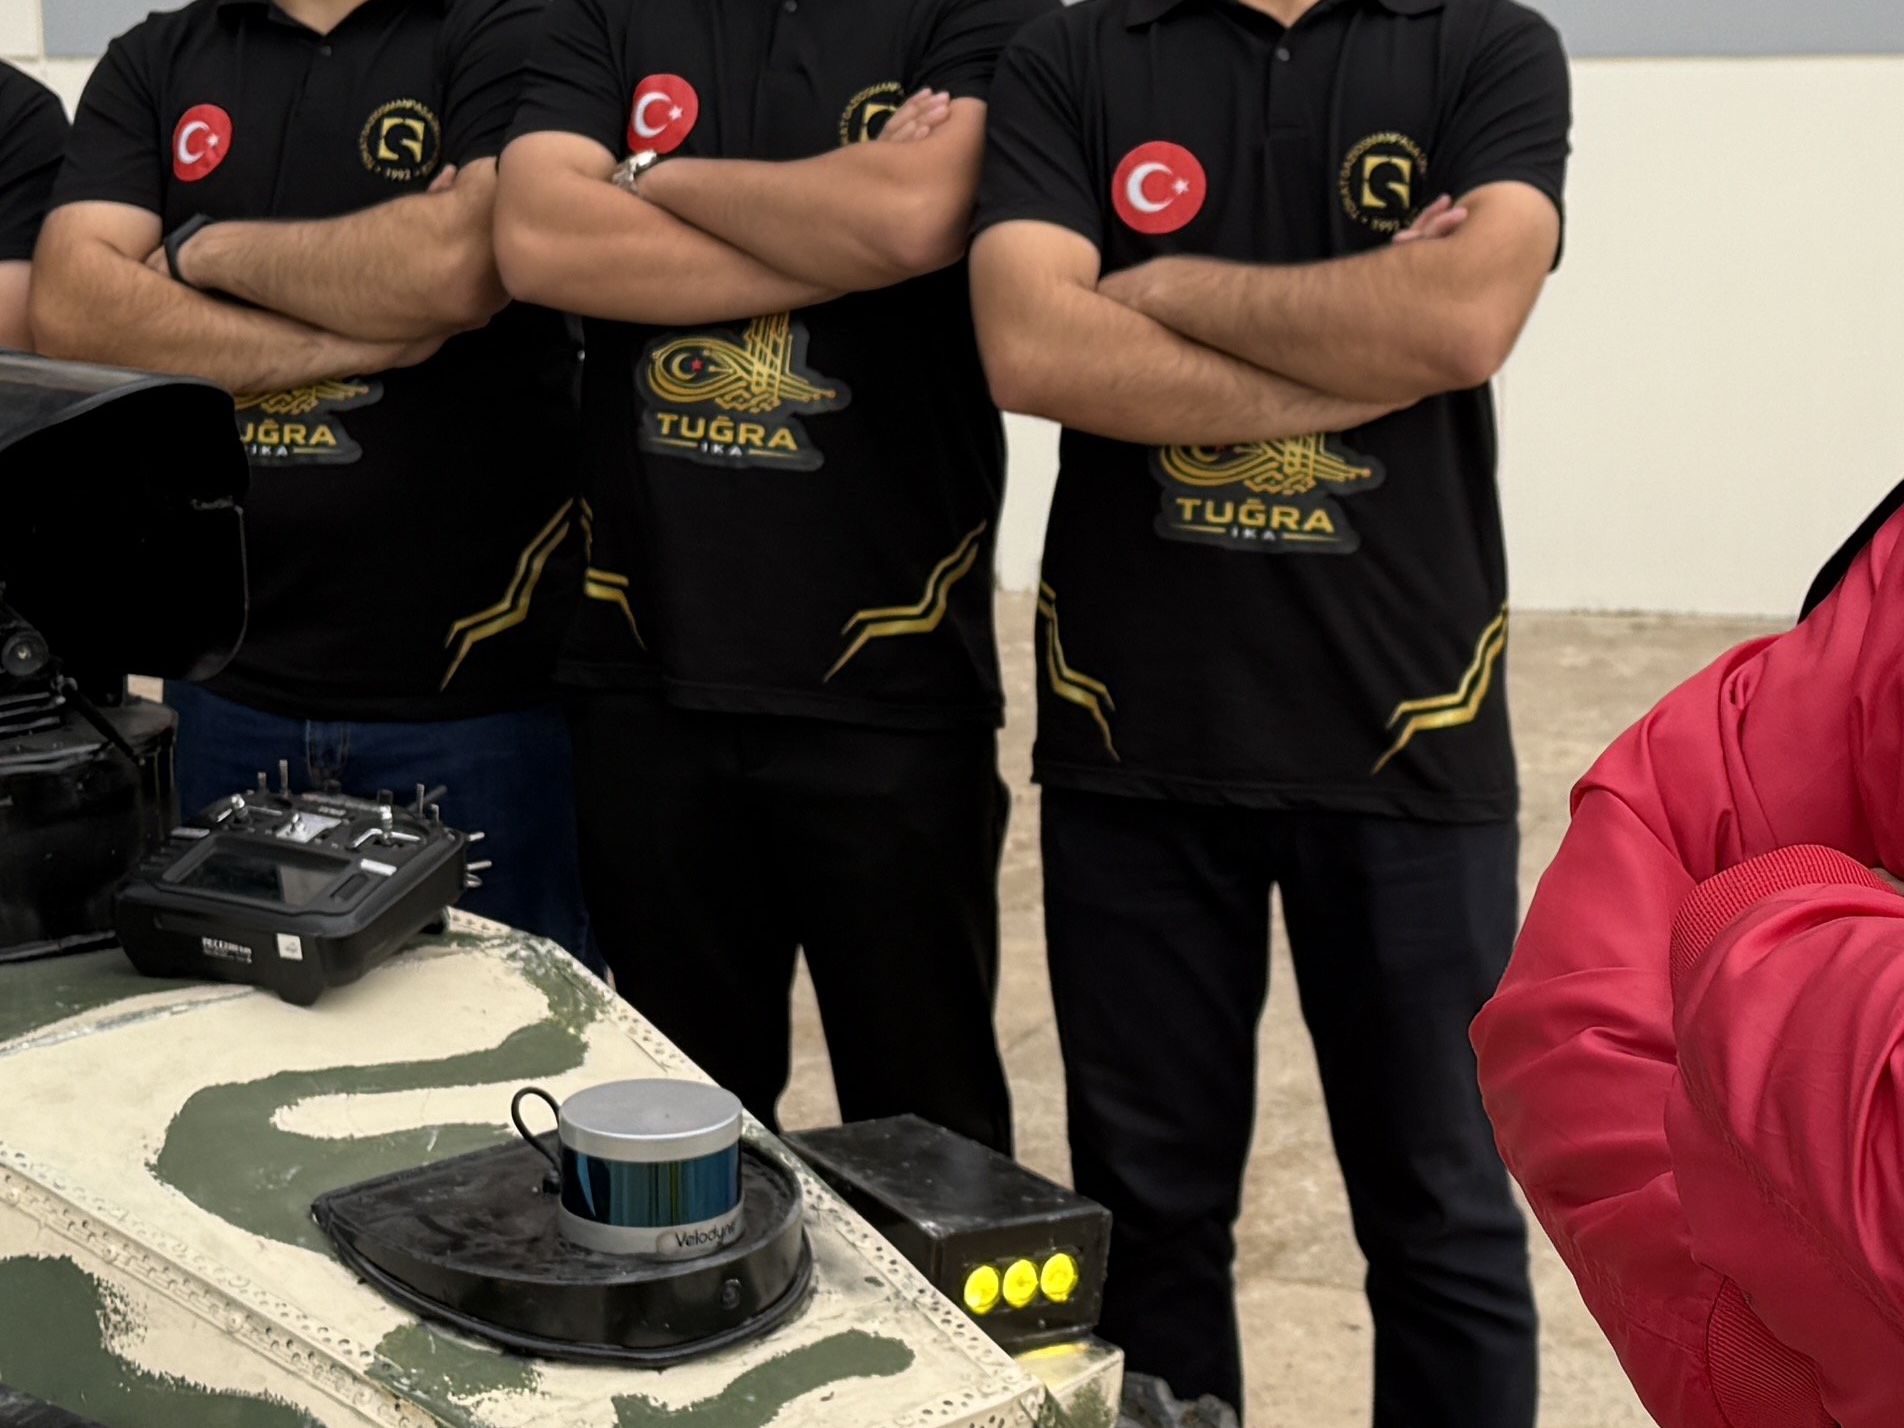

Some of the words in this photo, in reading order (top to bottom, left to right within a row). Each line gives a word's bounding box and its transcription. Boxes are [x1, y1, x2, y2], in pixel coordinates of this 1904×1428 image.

[239, 418, 337, 446] UĞRA
[657, 412, 798, 451] TUĞRA
[1175, 497, 1335, 534] TUĞRA
